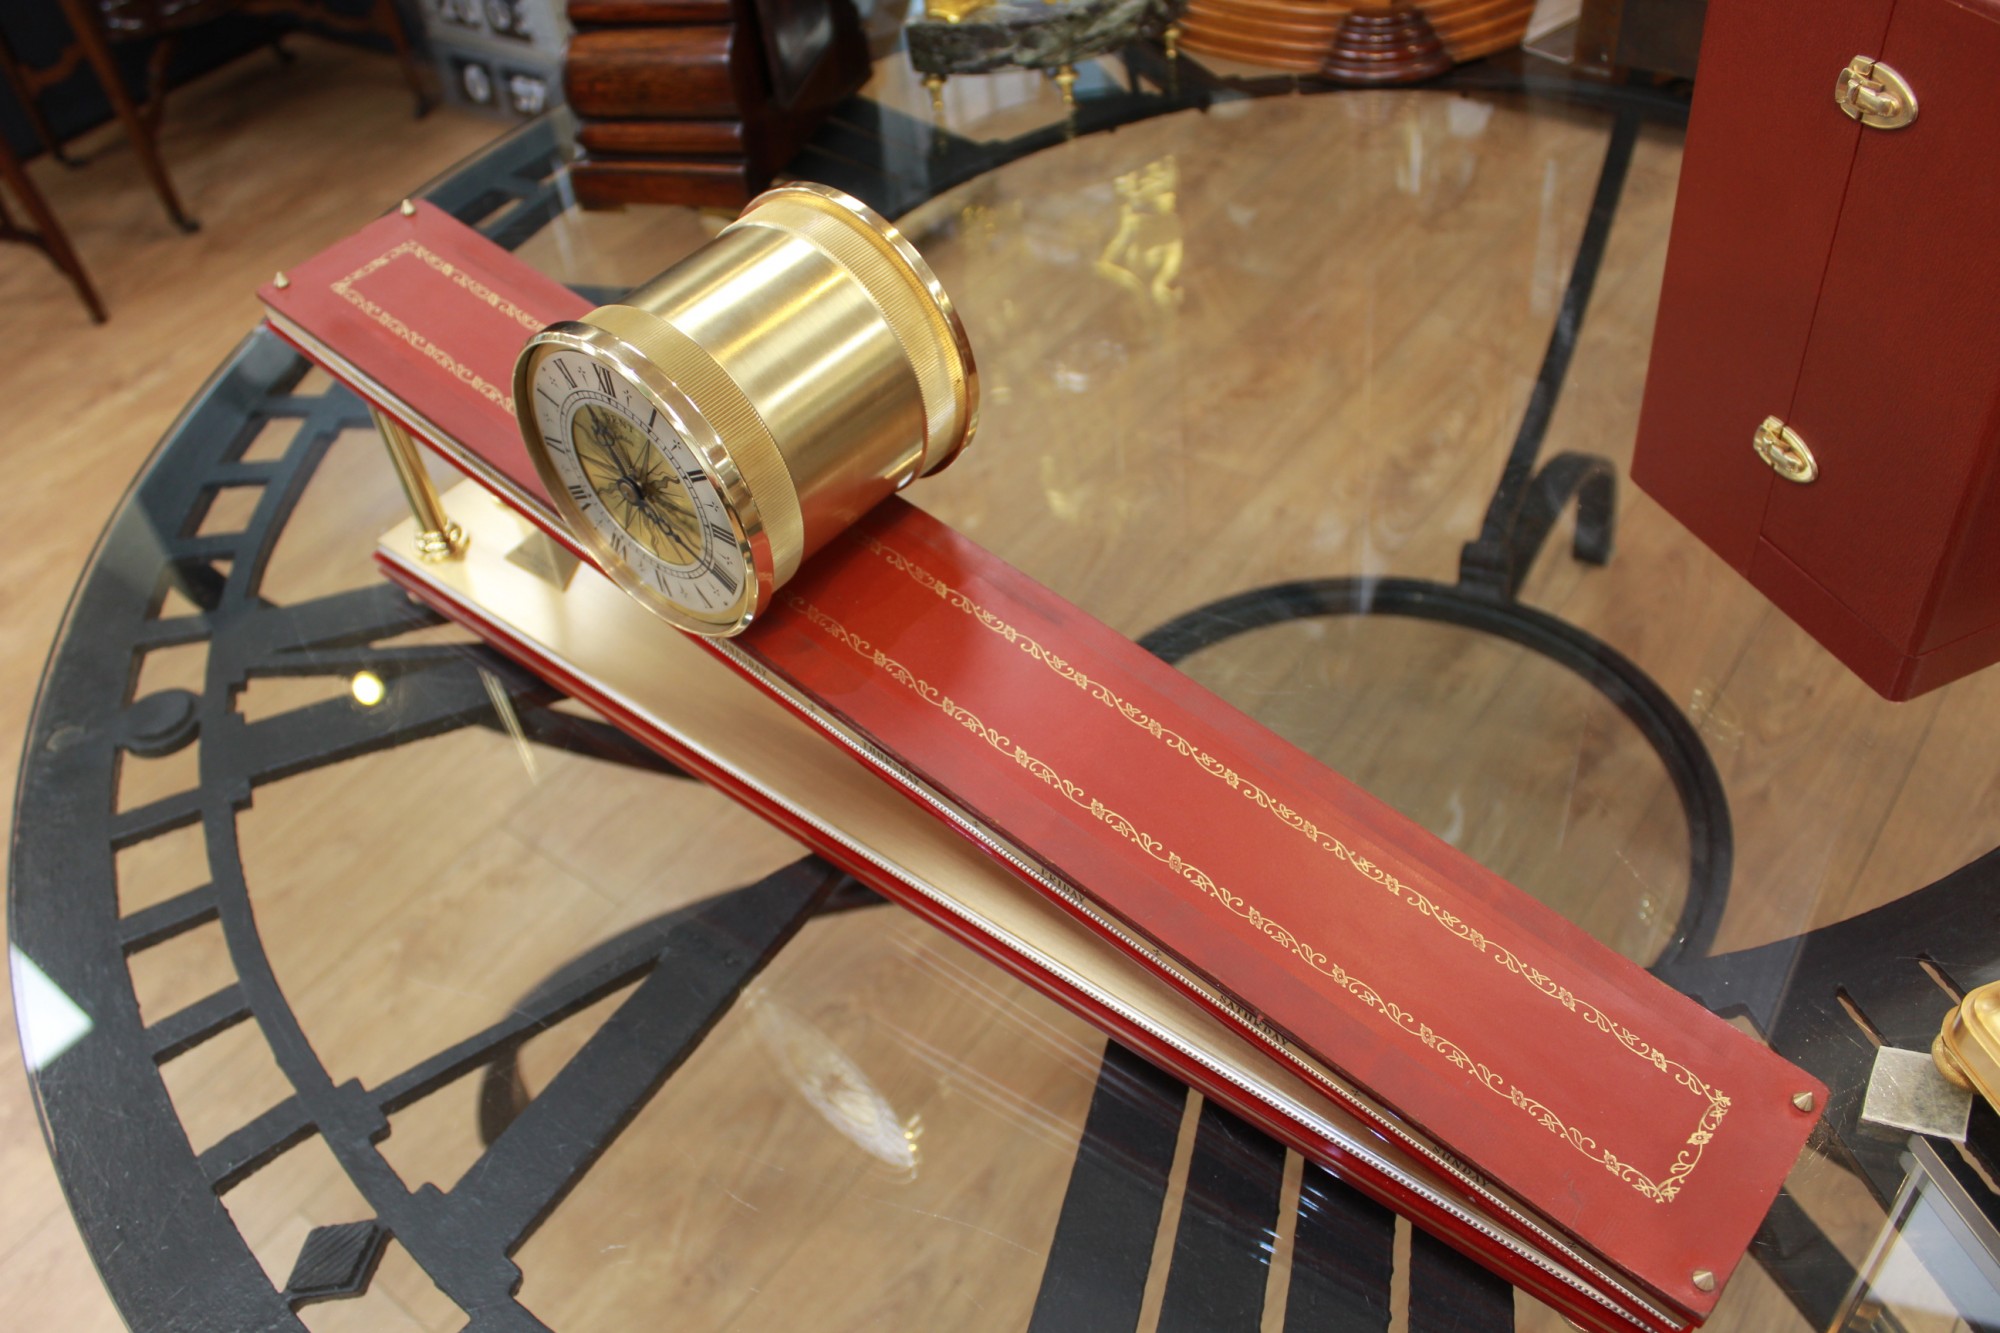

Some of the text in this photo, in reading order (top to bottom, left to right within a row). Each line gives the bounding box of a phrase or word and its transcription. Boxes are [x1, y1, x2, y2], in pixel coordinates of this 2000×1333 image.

[592, 362, 617, 399] XII
[711, 522, 737, 549] III
[709, 637, 767, 677] EDNESDAY
[861, 740, 919, 785] THURSDAY
[1041, 868, 1086, 902] FRIDAY
[1220, 994, 1289, 1046] SATURDAY
[1433, 1146, 1488, 1187] SUNDAY
